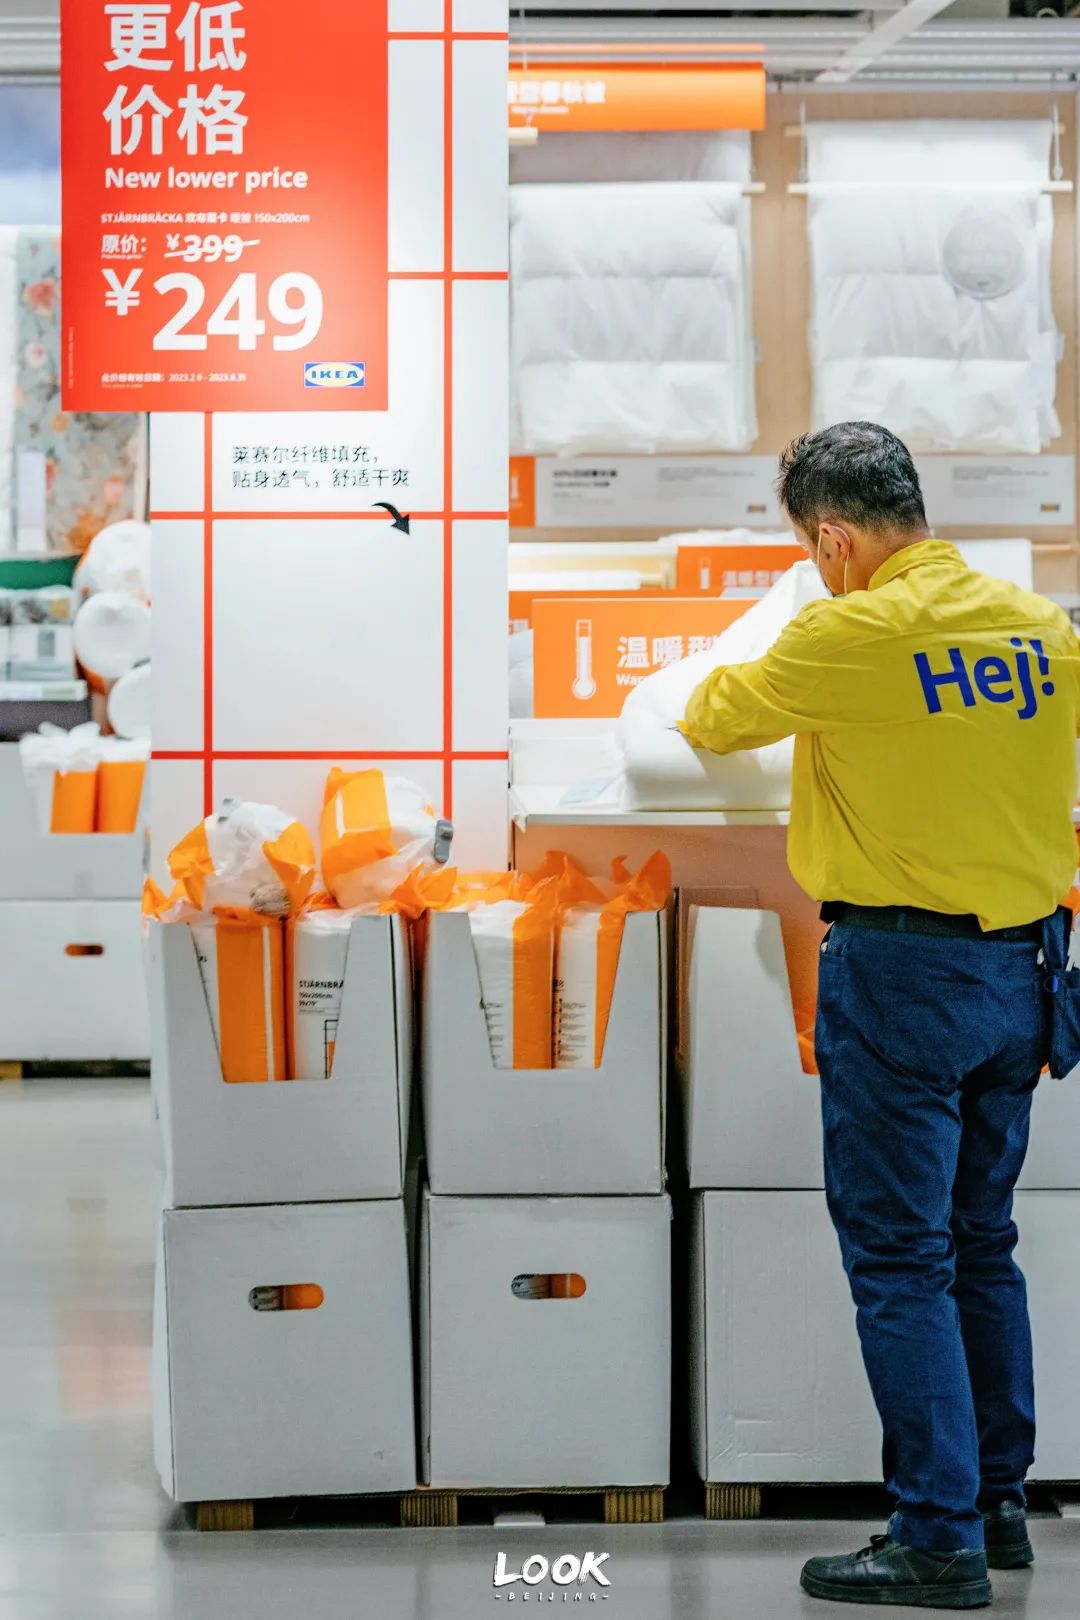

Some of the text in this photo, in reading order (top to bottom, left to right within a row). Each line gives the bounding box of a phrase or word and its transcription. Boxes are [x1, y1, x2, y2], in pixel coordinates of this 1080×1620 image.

[103, 1, 248, 73] 更低
[102, 83, 249, 156] 价格
[105, 167, 308, 194] New lower price
[311, 370, 359, 379] IKEA
[913, 637, 1055, 720] Hej!
